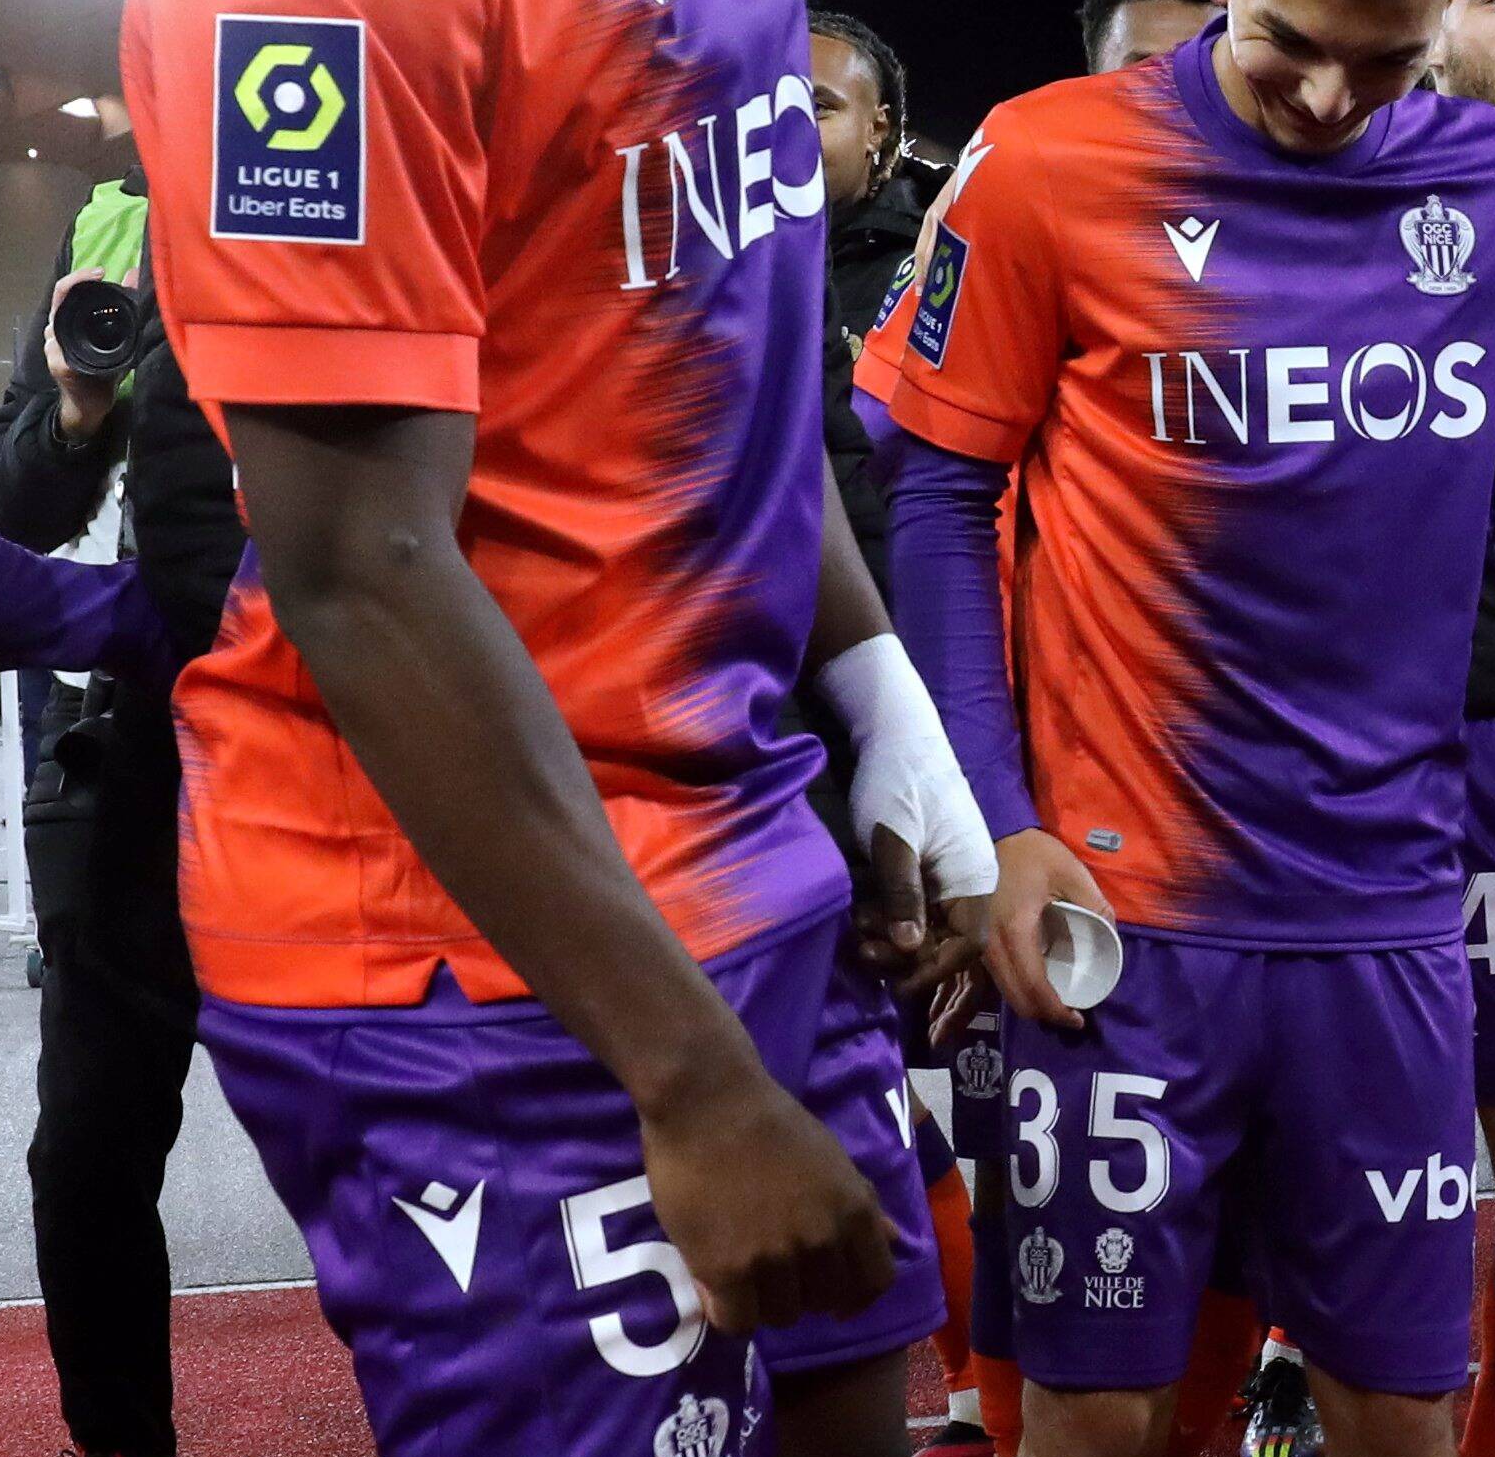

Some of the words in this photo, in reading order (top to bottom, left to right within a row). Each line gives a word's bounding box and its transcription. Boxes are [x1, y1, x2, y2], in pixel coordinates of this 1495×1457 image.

[238, 165, 321, 190] LIGUE
[327, 170, 340, 190] 1
[615, 74, 826, 290] INEO
[228, 194, 285, 217] Uber
[289, 197, 347, 220] Eats
[1422, 223, 1453, 235] OGC
[1423, 233, 1454, 245] NICE
[1142, 341, 1488, 445] INEOS
[1007, 1068, 1170, 1214] 35
[559, 1174, 707, 1378] 5
[1084, 1276, 1122, 1289] VILLE
[1125, 1276, 1145, 1289] DE
[1085, 1288, 1145, 1309] NICE
